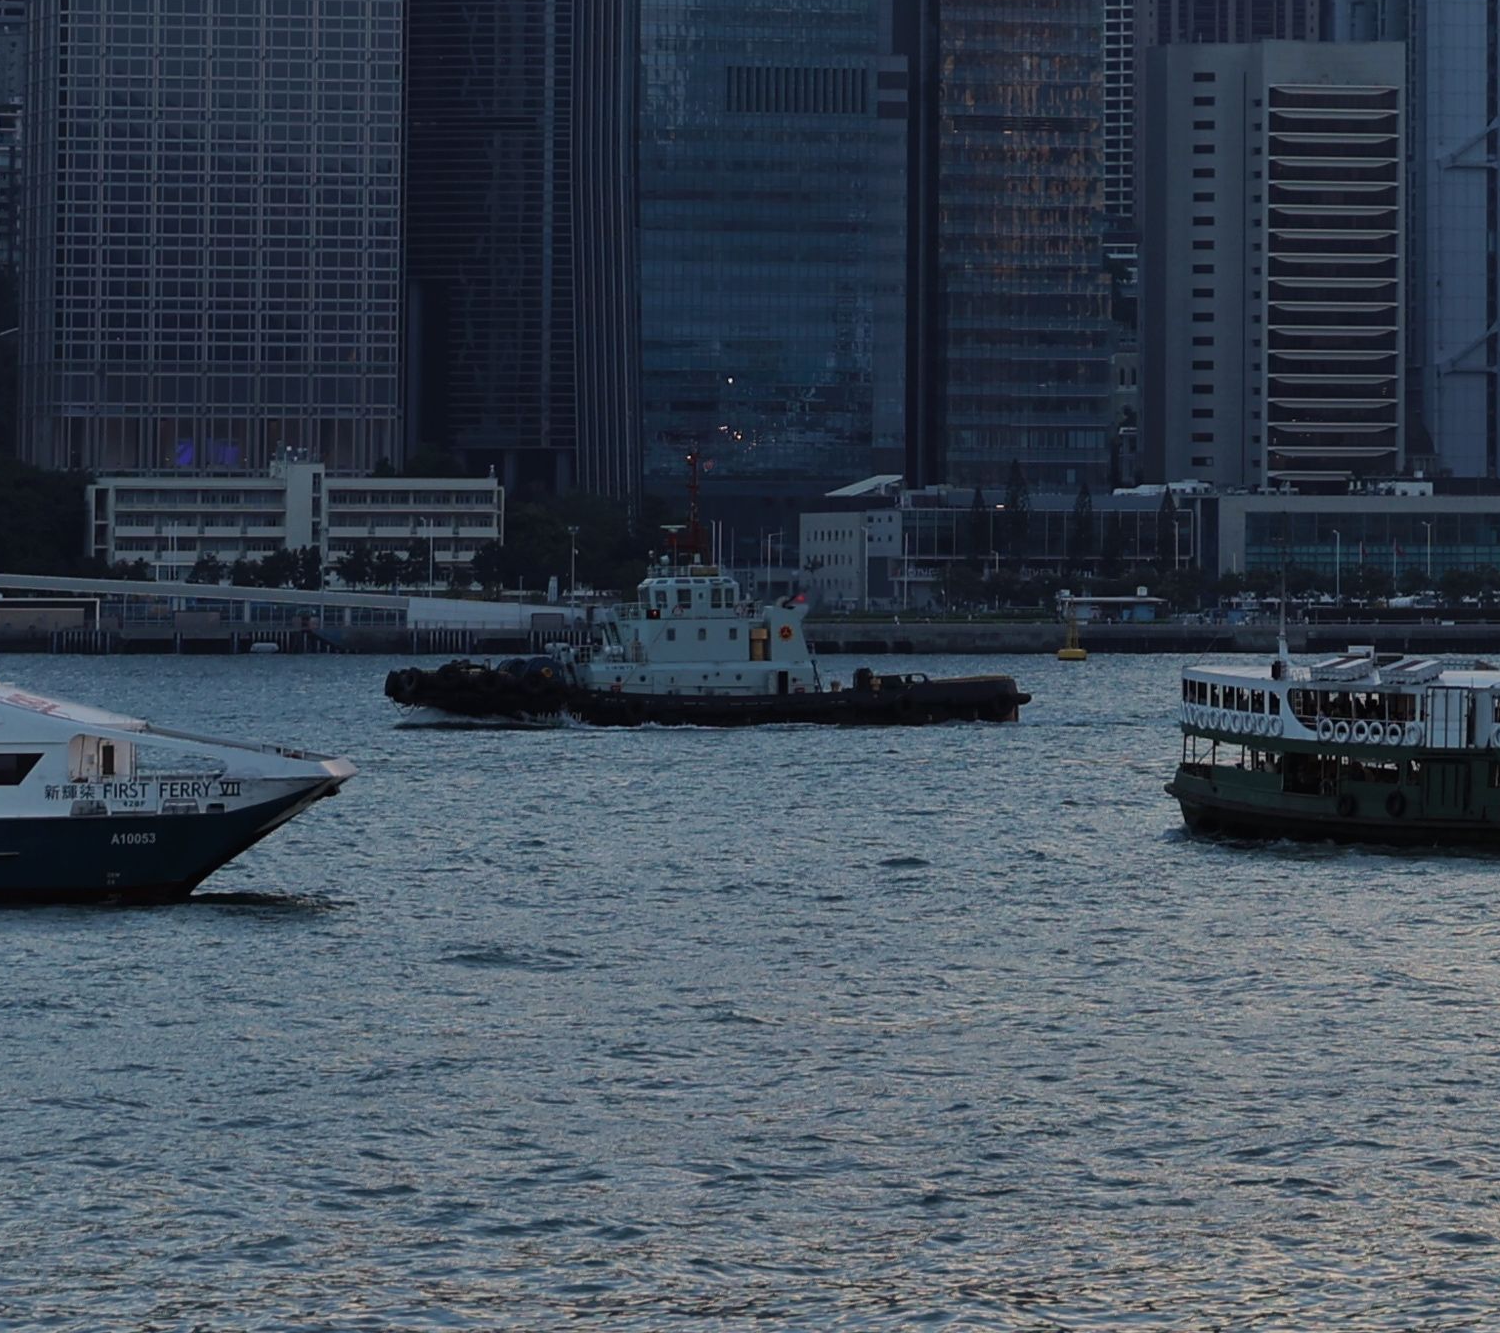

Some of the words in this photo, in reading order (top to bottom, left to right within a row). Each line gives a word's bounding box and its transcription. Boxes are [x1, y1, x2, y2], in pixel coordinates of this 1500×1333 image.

[103, 782, 149, 799] FIRST
[159, 781, 212, 798] FERRY
[219, 781, 241, 797] VII
[111, 833, 156, 845] A10053
